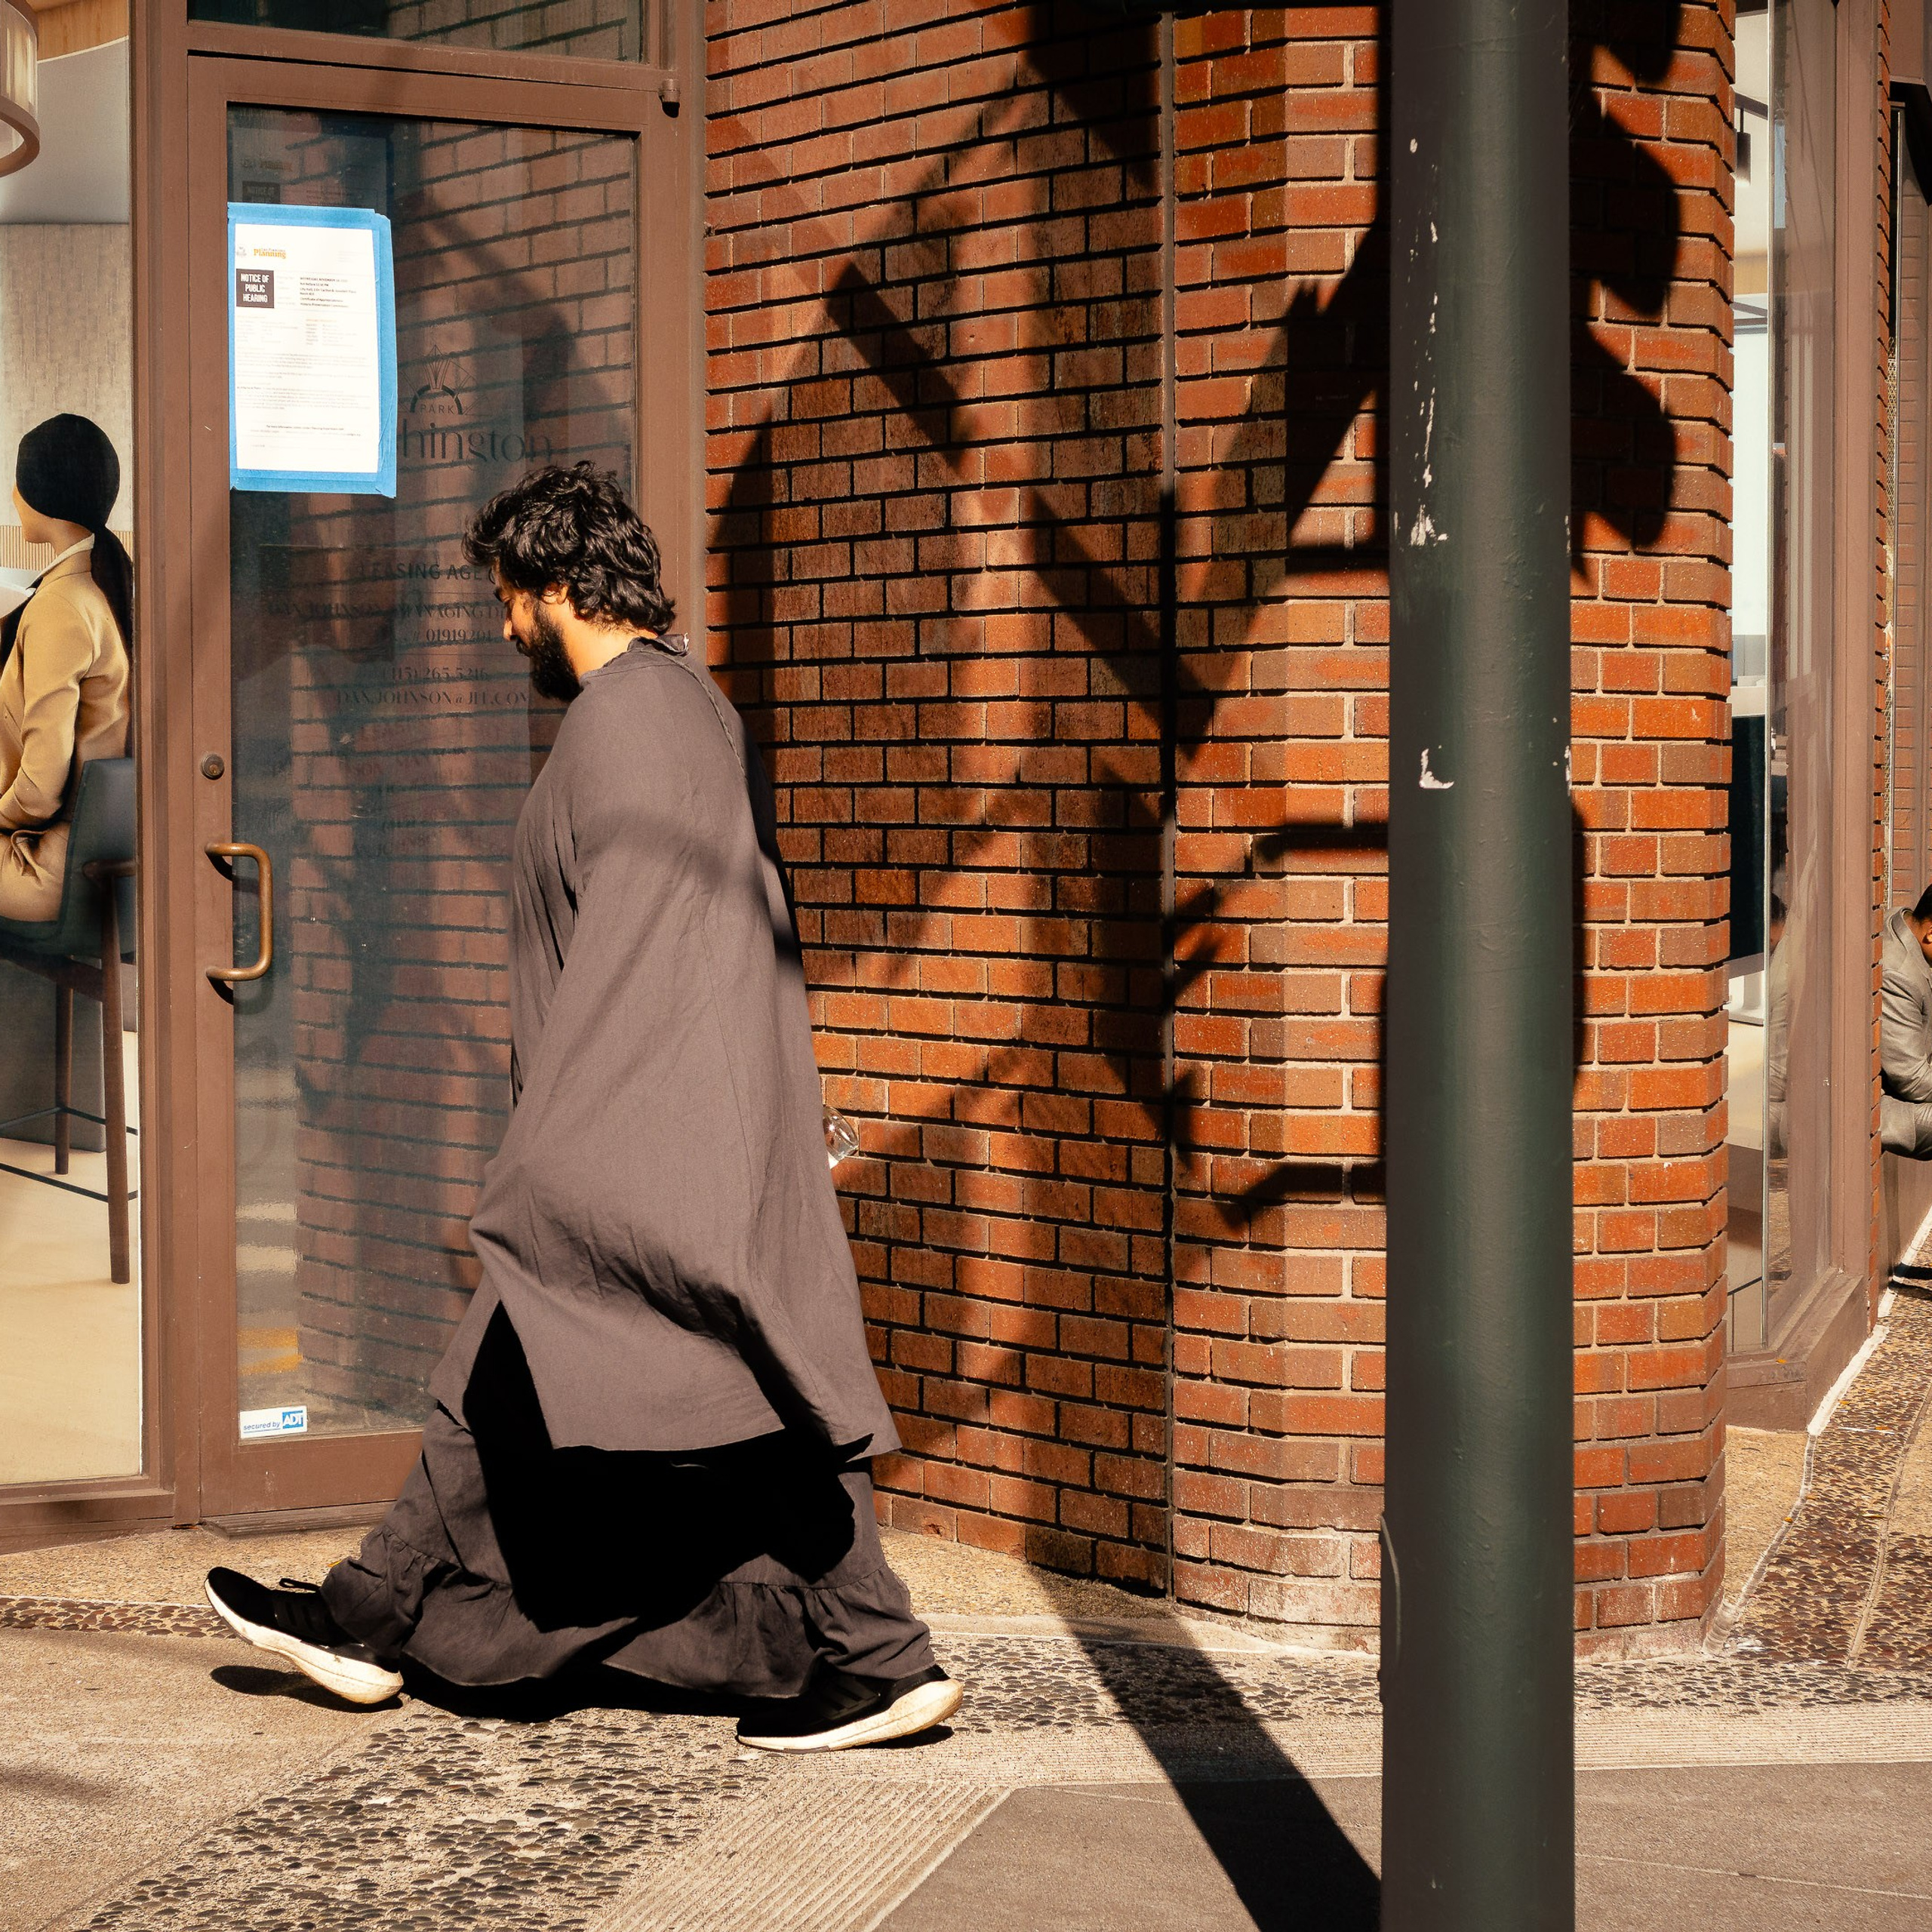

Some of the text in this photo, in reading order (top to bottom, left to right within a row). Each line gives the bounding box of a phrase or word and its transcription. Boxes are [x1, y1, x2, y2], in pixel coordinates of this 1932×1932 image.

[254, 248, 286, 259] Planning
[241, 273, 269, 283] NOTICE OF
[245, 284, 266, 293] PUBLIC
[243, 294, 268, 303] HEARING
[420, 404, 454, 414] PARK
[403, 418, 552, 471] hington
[447, 564, 482, 580] AGE
[244, 1422, 271, 1430] secured
[283, 1413, 303, 1426] ADT
